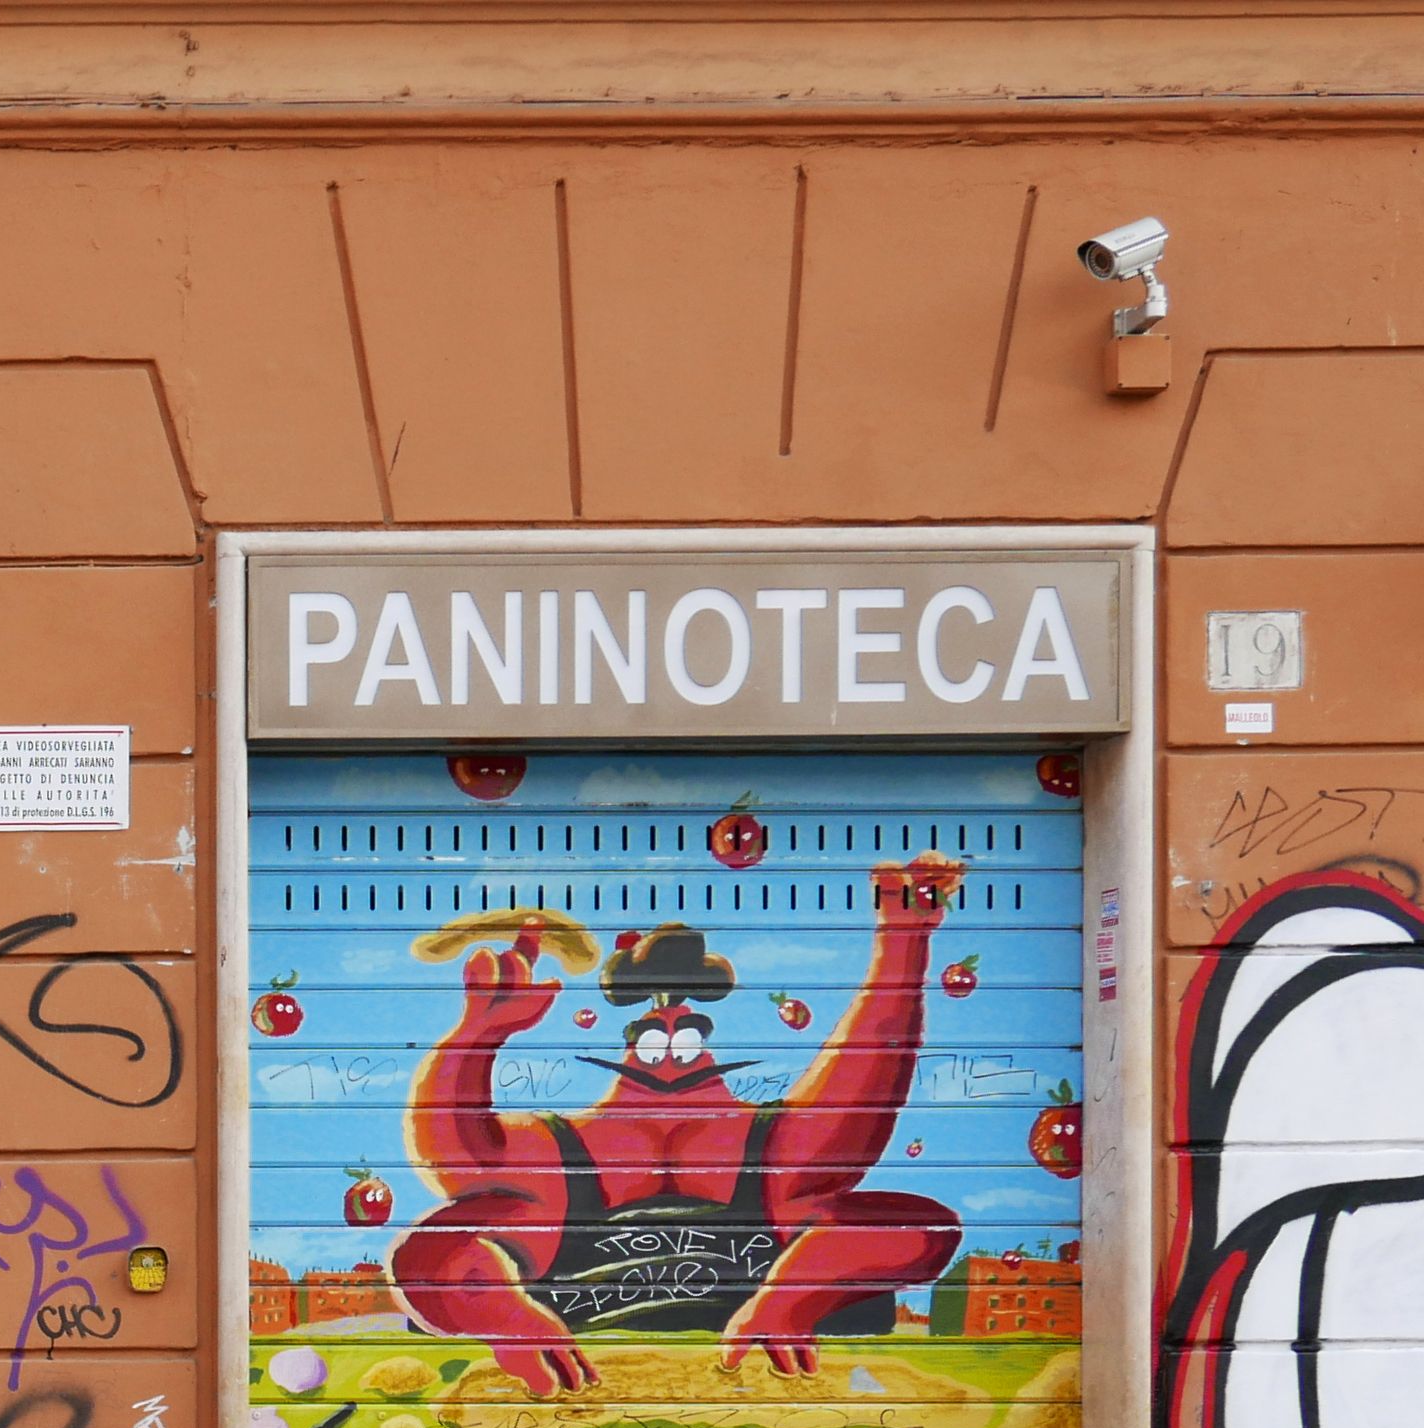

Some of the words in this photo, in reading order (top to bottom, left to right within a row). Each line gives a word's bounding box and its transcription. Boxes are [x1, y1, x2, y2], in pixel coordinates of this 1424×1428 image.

[288, 586, 1090, 707] PANINOTECA
[1219, 622, 1287, 680] 19
[16, 740, 115, 751] VIDEOSORVEGLIATA
[28, 757, 68, 768] ARRECATI
[74, 756, 115, 768] SARANNO
[40, 773, 52, 784] DI
[60, 773, 115, 784] DENUNCIA
[0, 806, 11, 817] 13
[12, 806, 20, 818] di
[22, 806, 65, 820] protezione
[99, 806, 115, 818] 196
